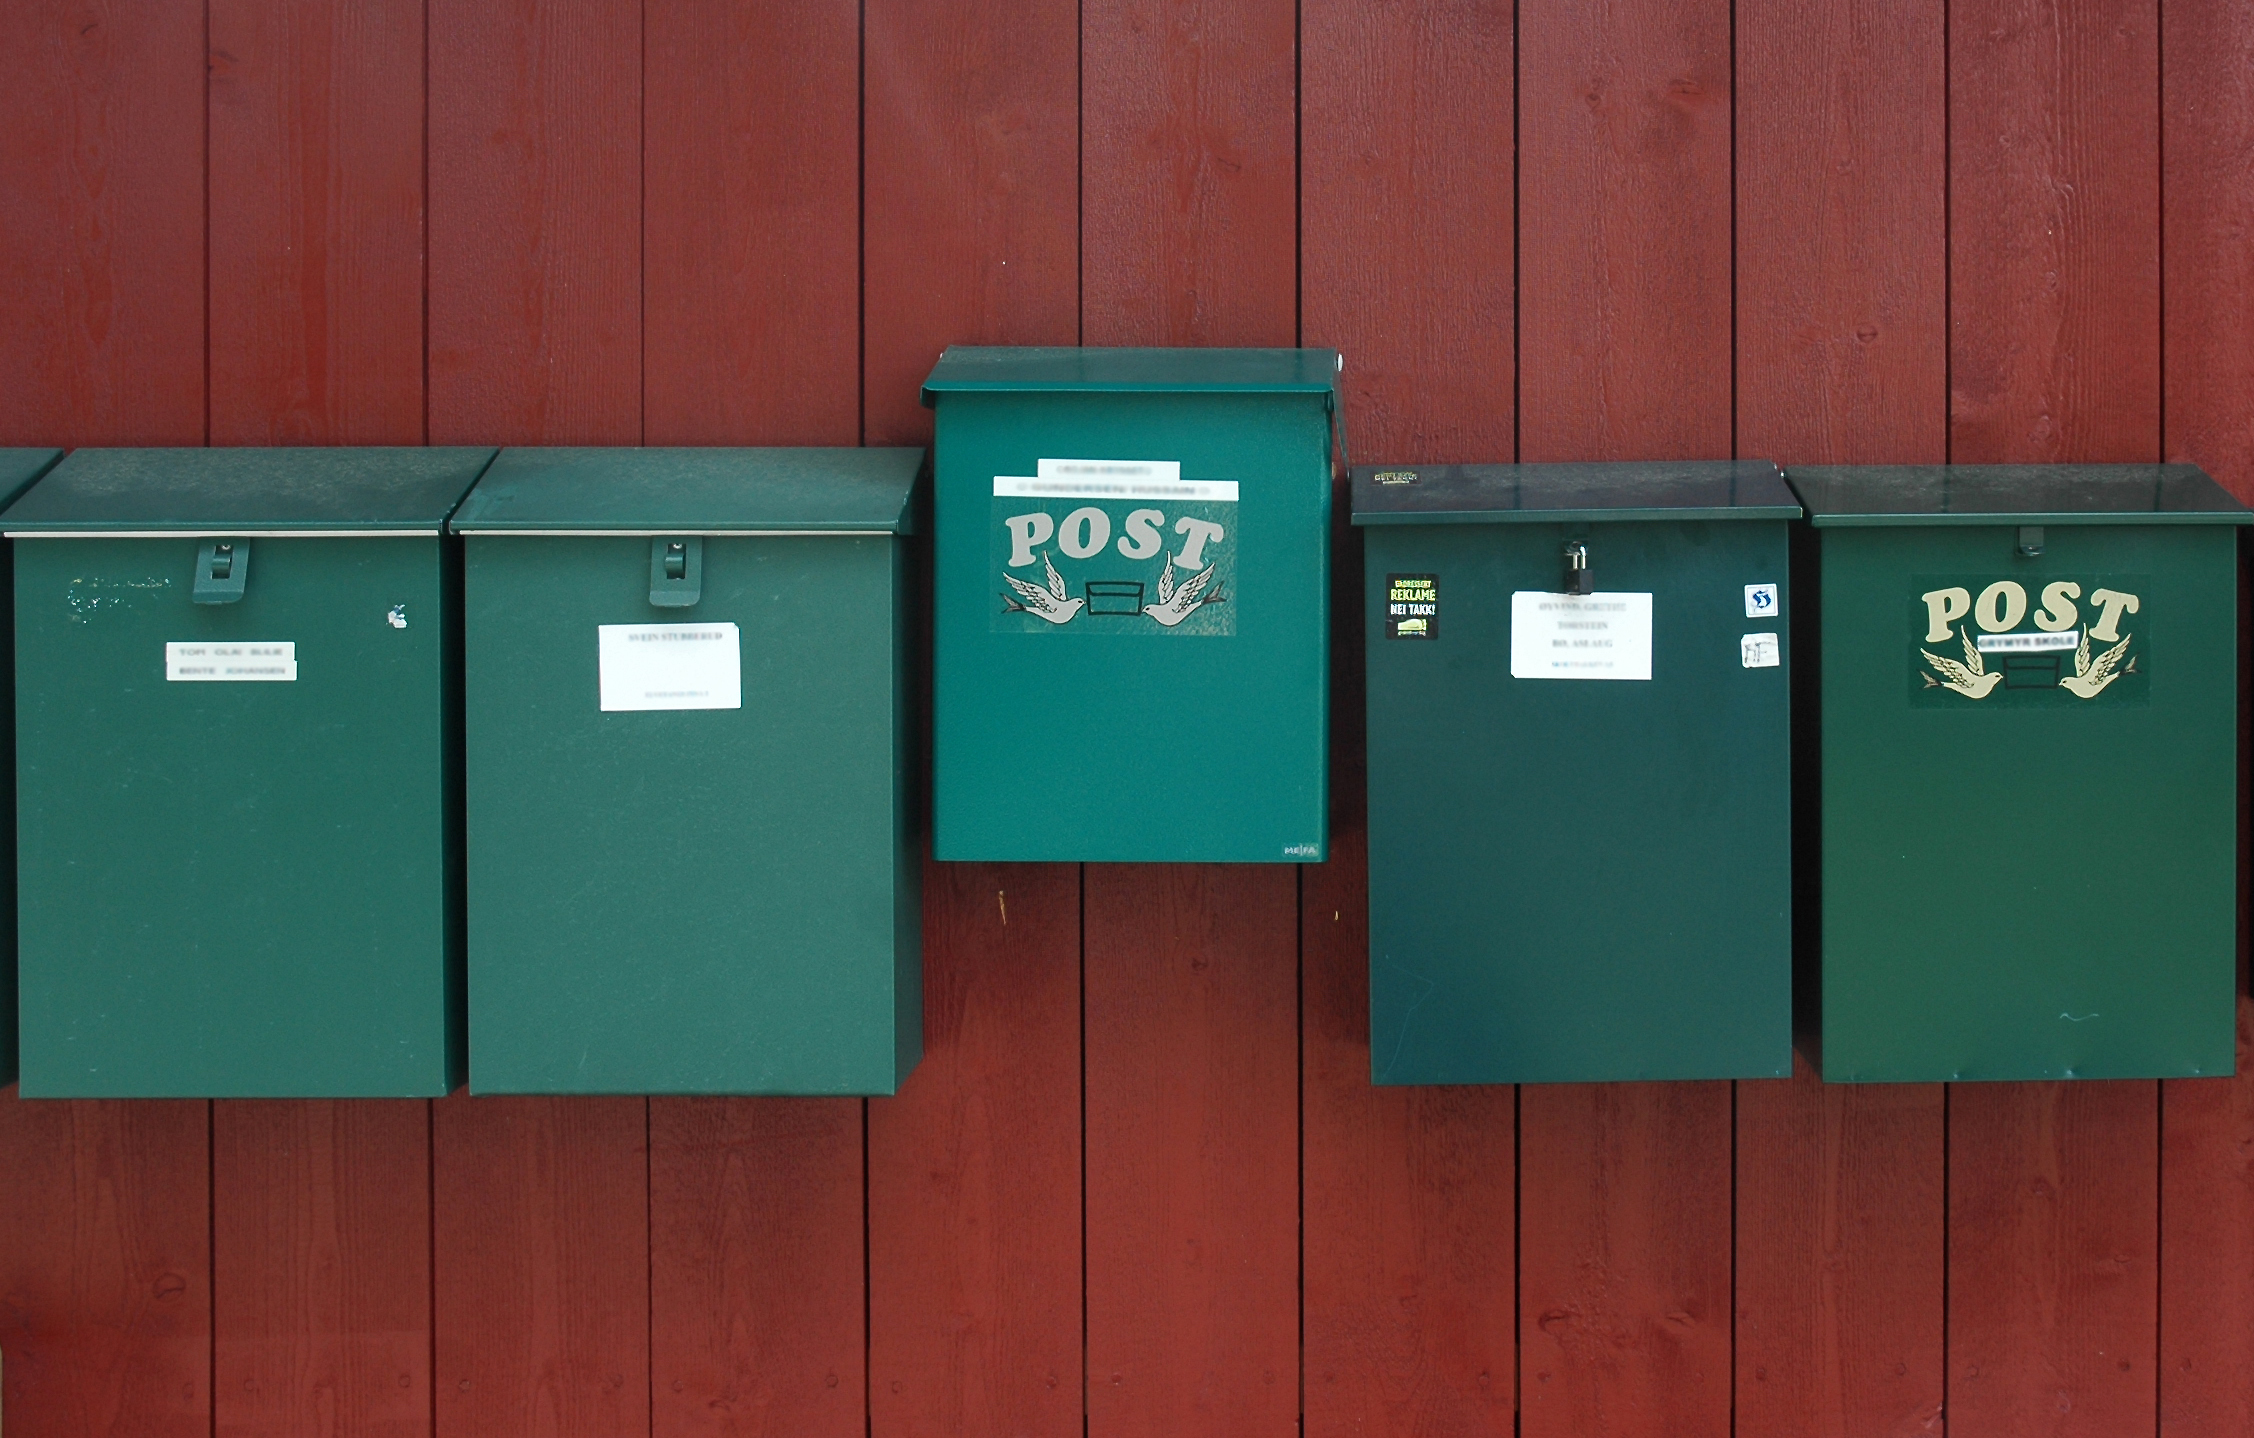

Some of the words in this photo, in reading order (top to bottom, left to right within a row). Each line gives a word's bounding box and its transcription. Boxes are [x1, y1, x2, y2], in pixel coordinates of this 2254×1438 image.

[1005, 506, 1224, 570] POST
[1390, 588, 1436, 601] REKLAME
[1390, 603, 1407, 615] NEI
[1408, 603, 1436, 616] TAKK!
[1921, 580, 2139, 643] POST
[2034, 636, 2075, 646] SKOLE
